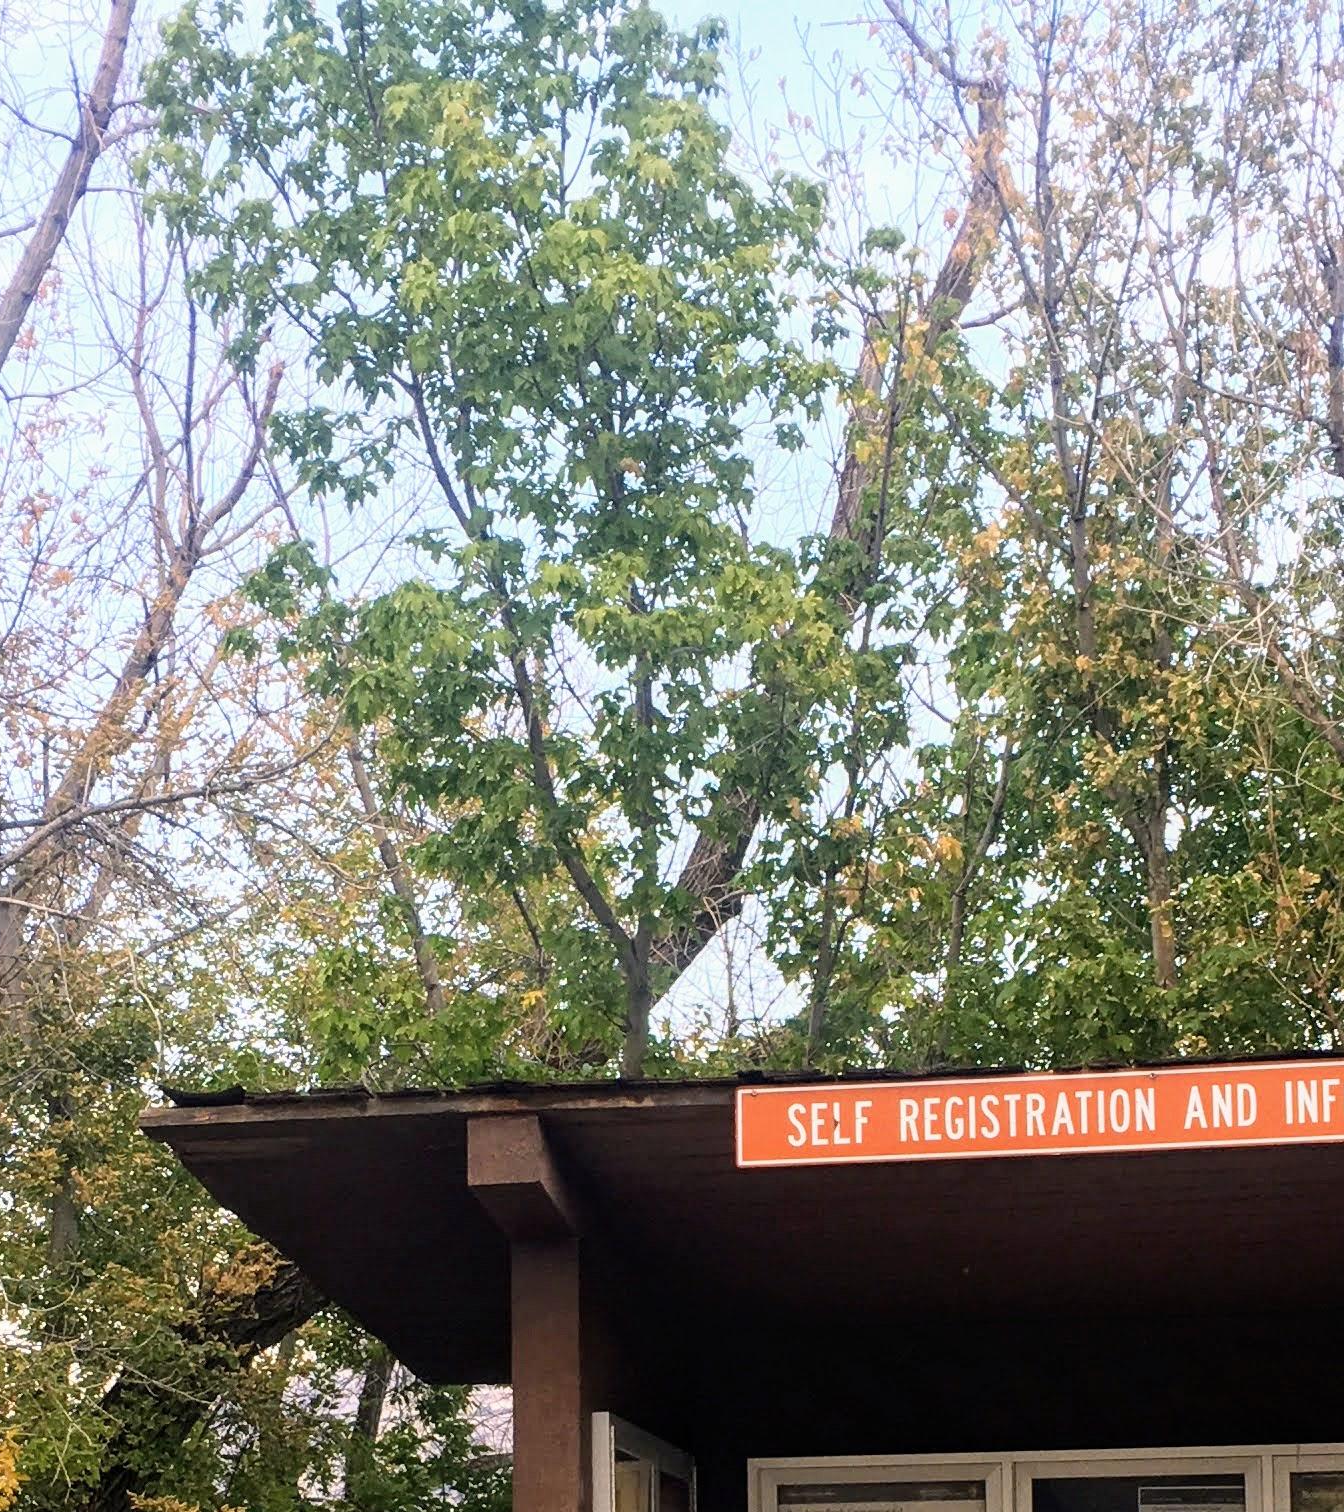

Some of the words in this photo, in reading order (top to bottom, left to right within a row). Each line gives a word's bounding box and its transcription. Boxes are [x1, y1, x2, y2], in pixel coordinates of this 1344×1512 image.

[787, 1100, 873, 1147] SELF
[899, 1087, 1156, 1142] REGISTRATION
[1184, 1083, 1258, 1130] AND
